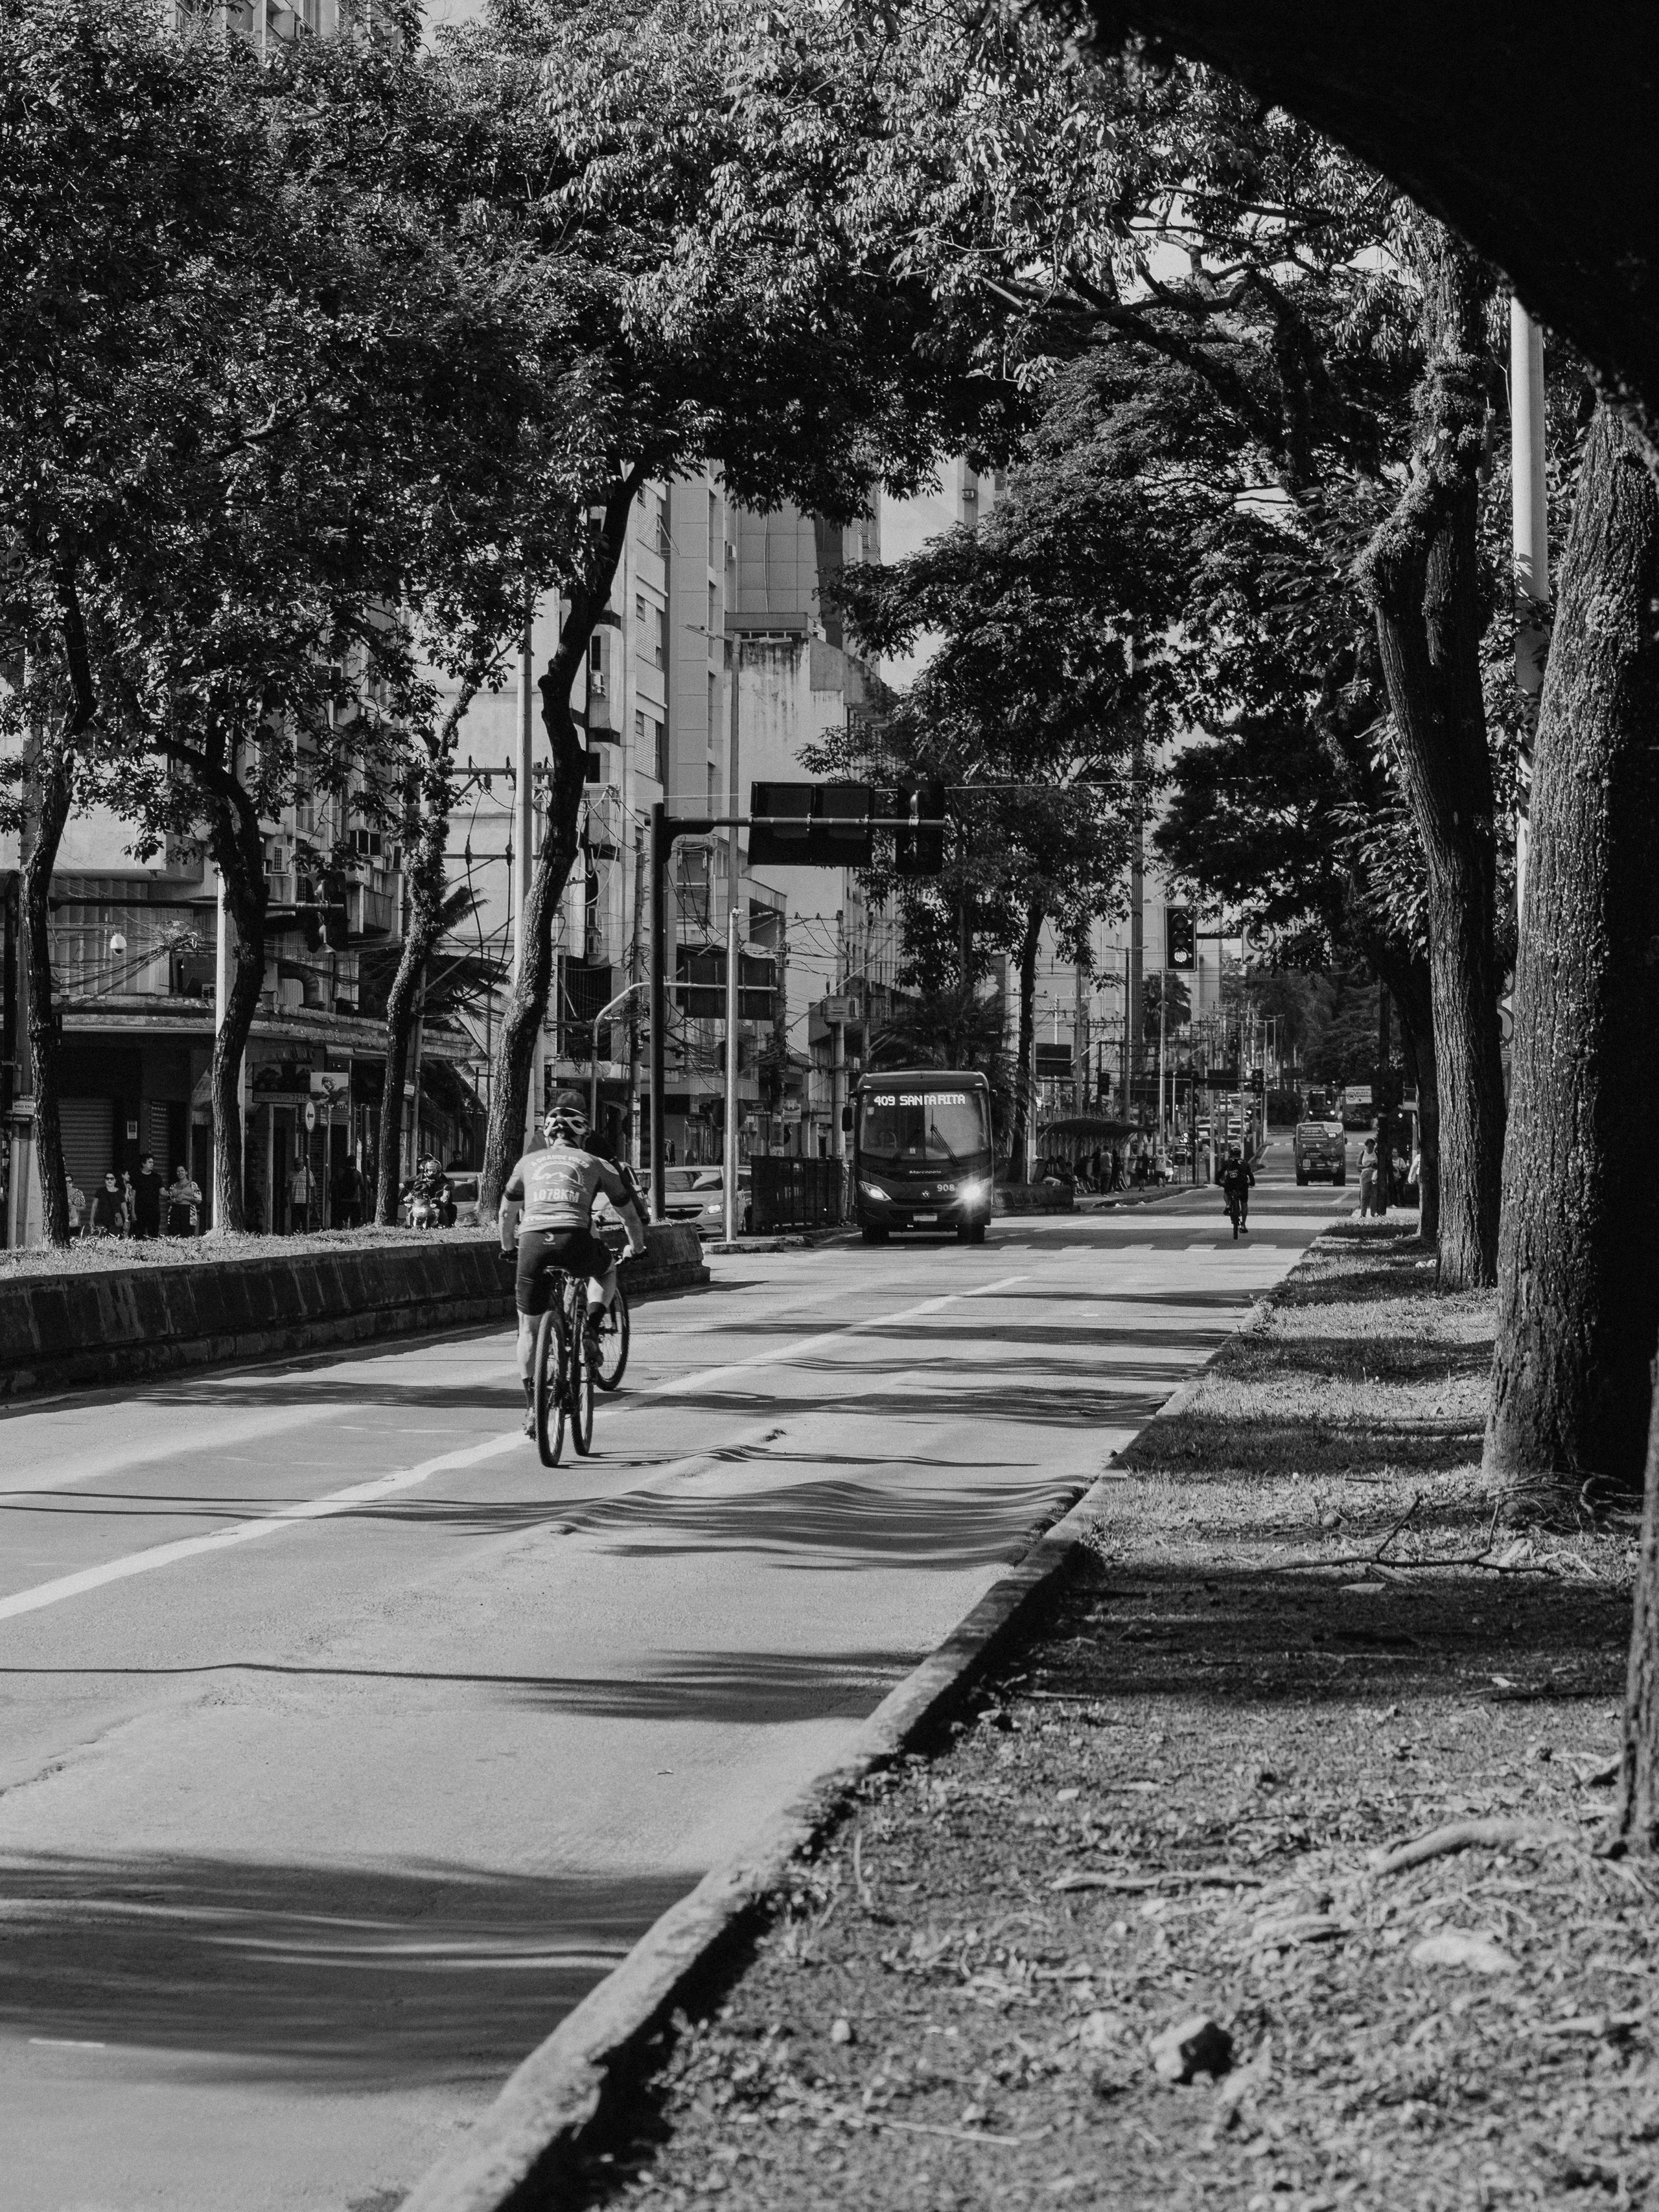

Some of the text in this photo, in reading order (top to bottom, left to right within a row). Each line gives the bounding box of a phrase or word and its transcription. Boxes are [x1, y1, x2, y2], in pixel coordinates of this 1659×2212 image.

[874, 1094, 966, 1106] 409 SANTA RITA
[536, 1154, 568, 1163] GRANDE
